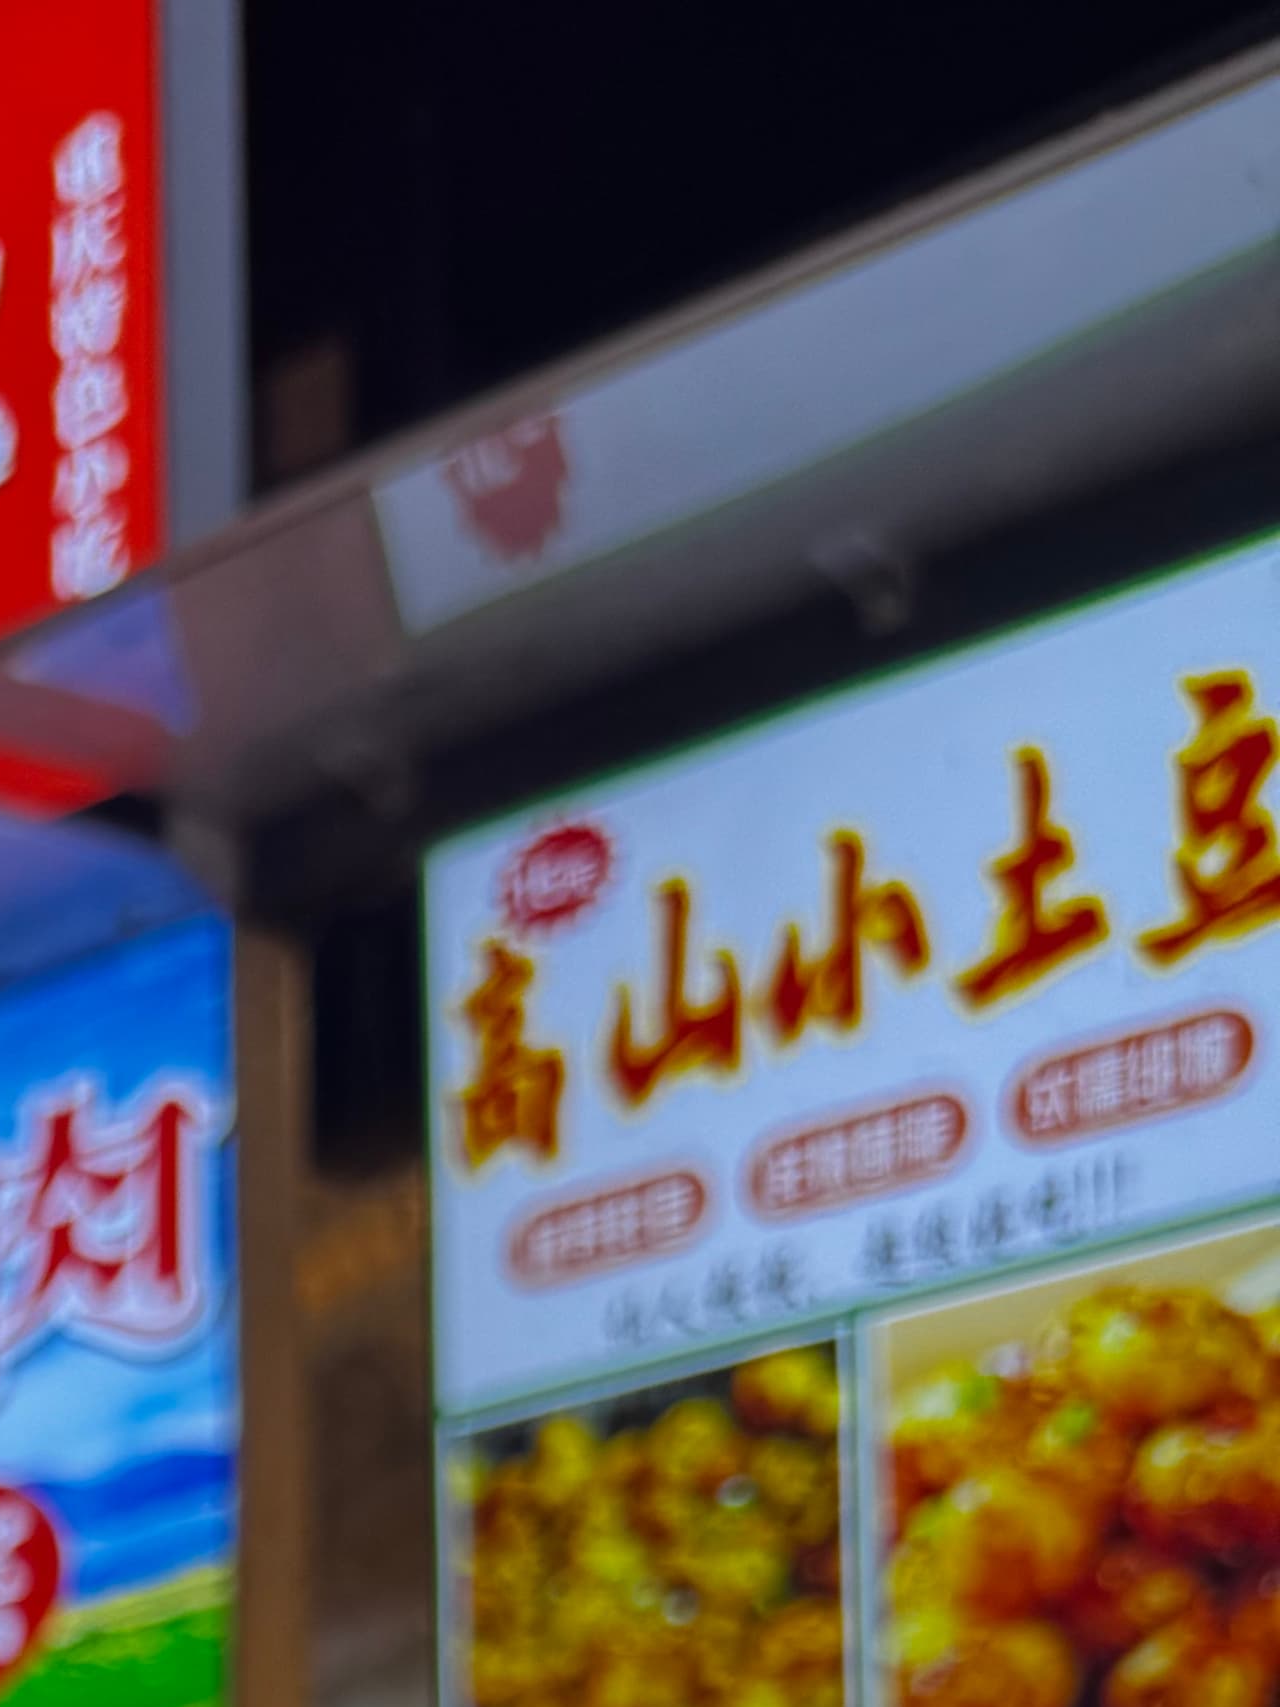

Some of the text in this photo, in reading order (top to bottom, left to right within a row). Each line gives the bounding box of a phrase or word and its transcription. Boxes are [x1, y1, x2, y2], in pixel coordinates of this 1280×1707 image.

[452, 668, 1280, 1165] 高山小土豆
